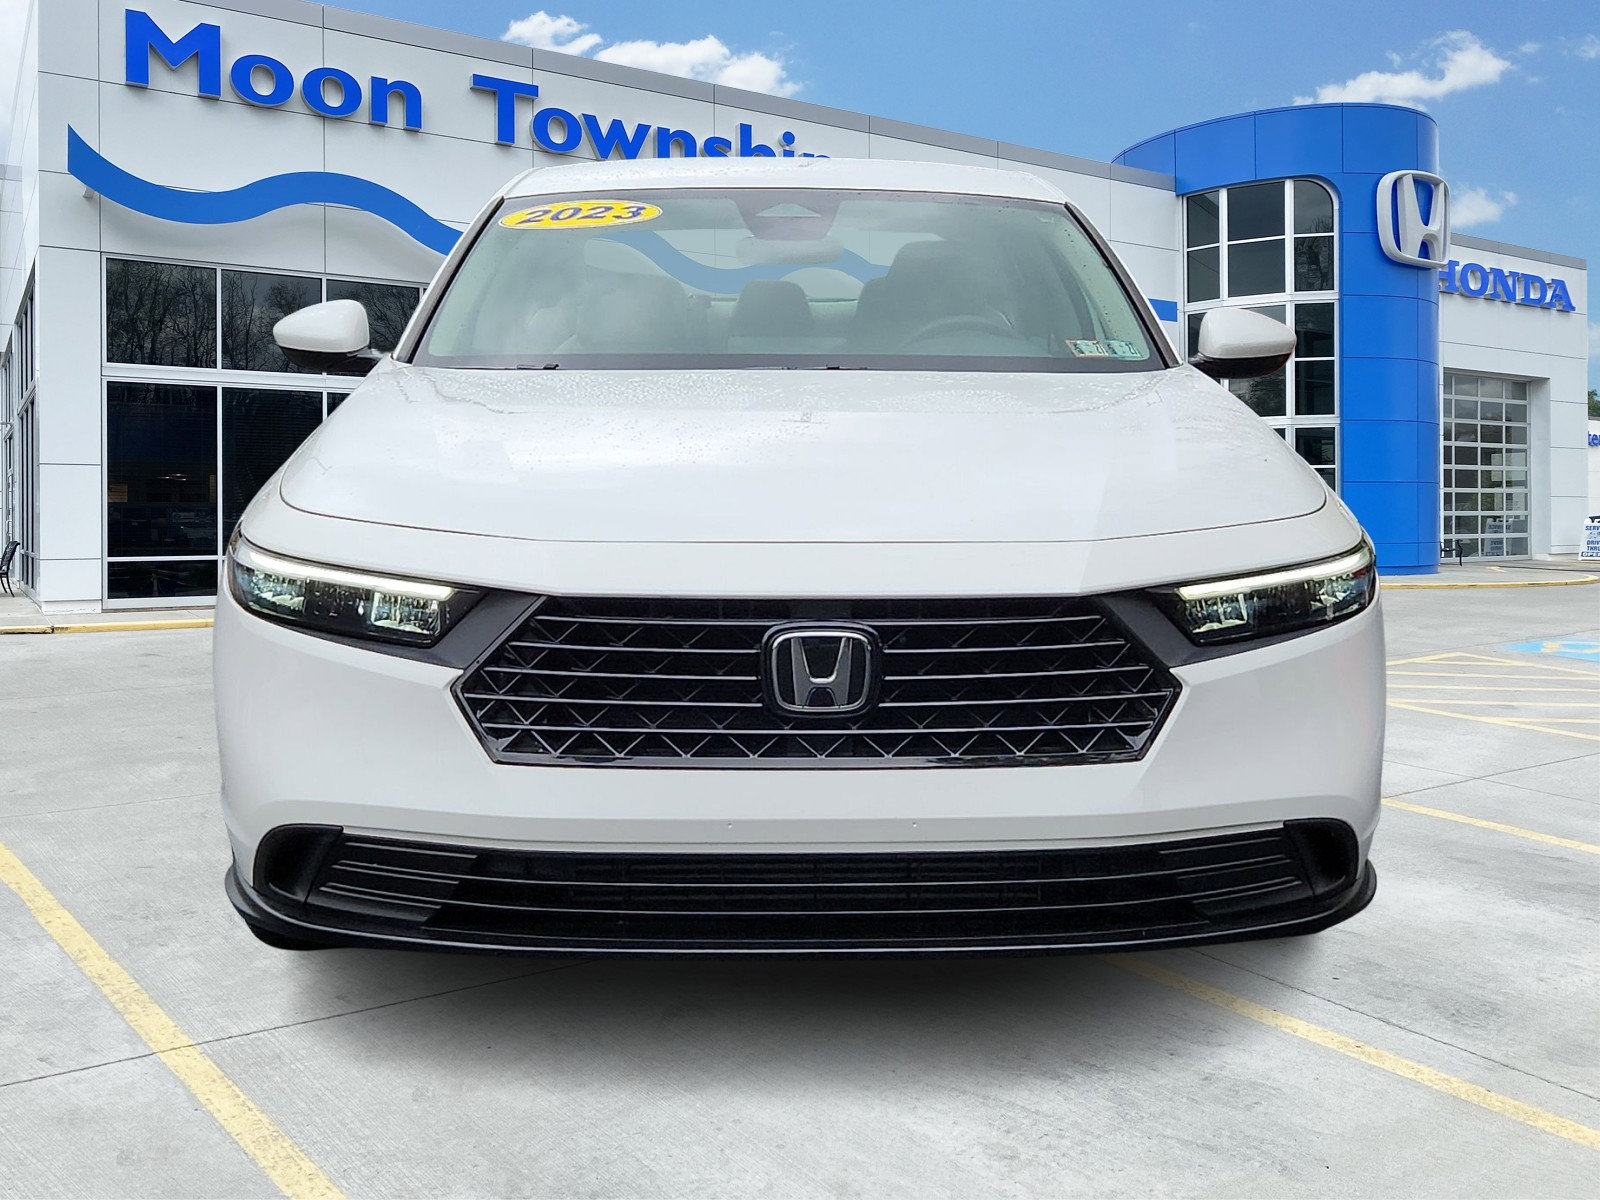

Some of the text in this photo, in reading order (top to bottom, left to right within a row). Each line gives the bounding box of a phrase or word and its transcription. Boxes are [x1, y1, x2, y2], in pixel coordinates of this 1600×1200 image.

[124, 8, 831, 160] Moon Townshi
[515, 205, 646, 225] 2023
[1439, 259, 1576, 312] HONDA
